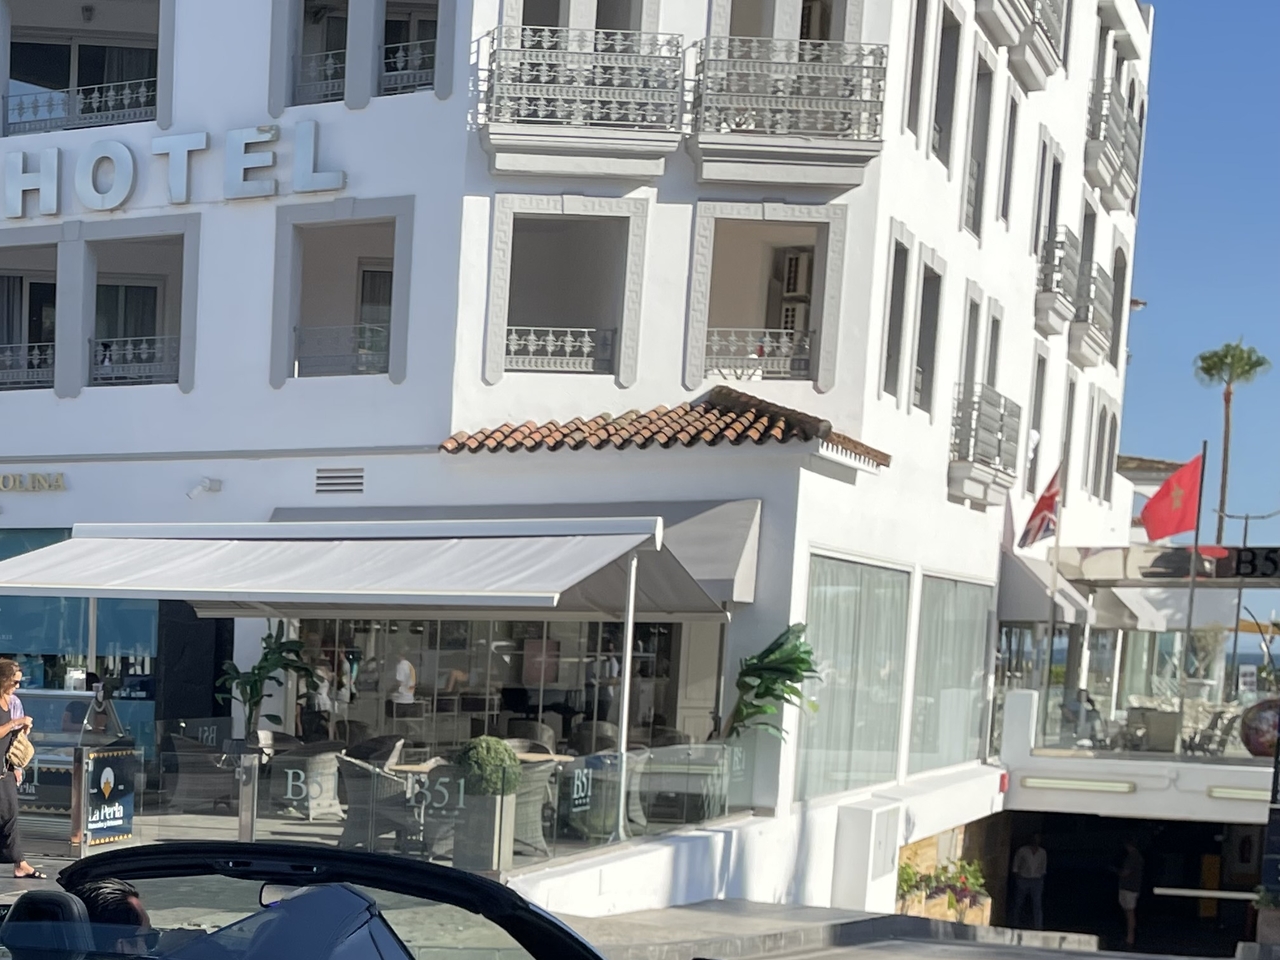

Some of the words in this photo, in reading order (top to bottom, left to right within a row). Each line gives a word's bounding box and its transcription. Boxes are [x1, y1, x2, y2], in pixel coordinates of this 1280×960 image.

[5, 119, 347, 219] HOTEL
[283, 768, 339, 801] B51
[406, 775, 467, 810] B51
[571, 768, 593, 799] B51
[88, 806, 100, 822] La
[100, 802, 124, 820] Perla
